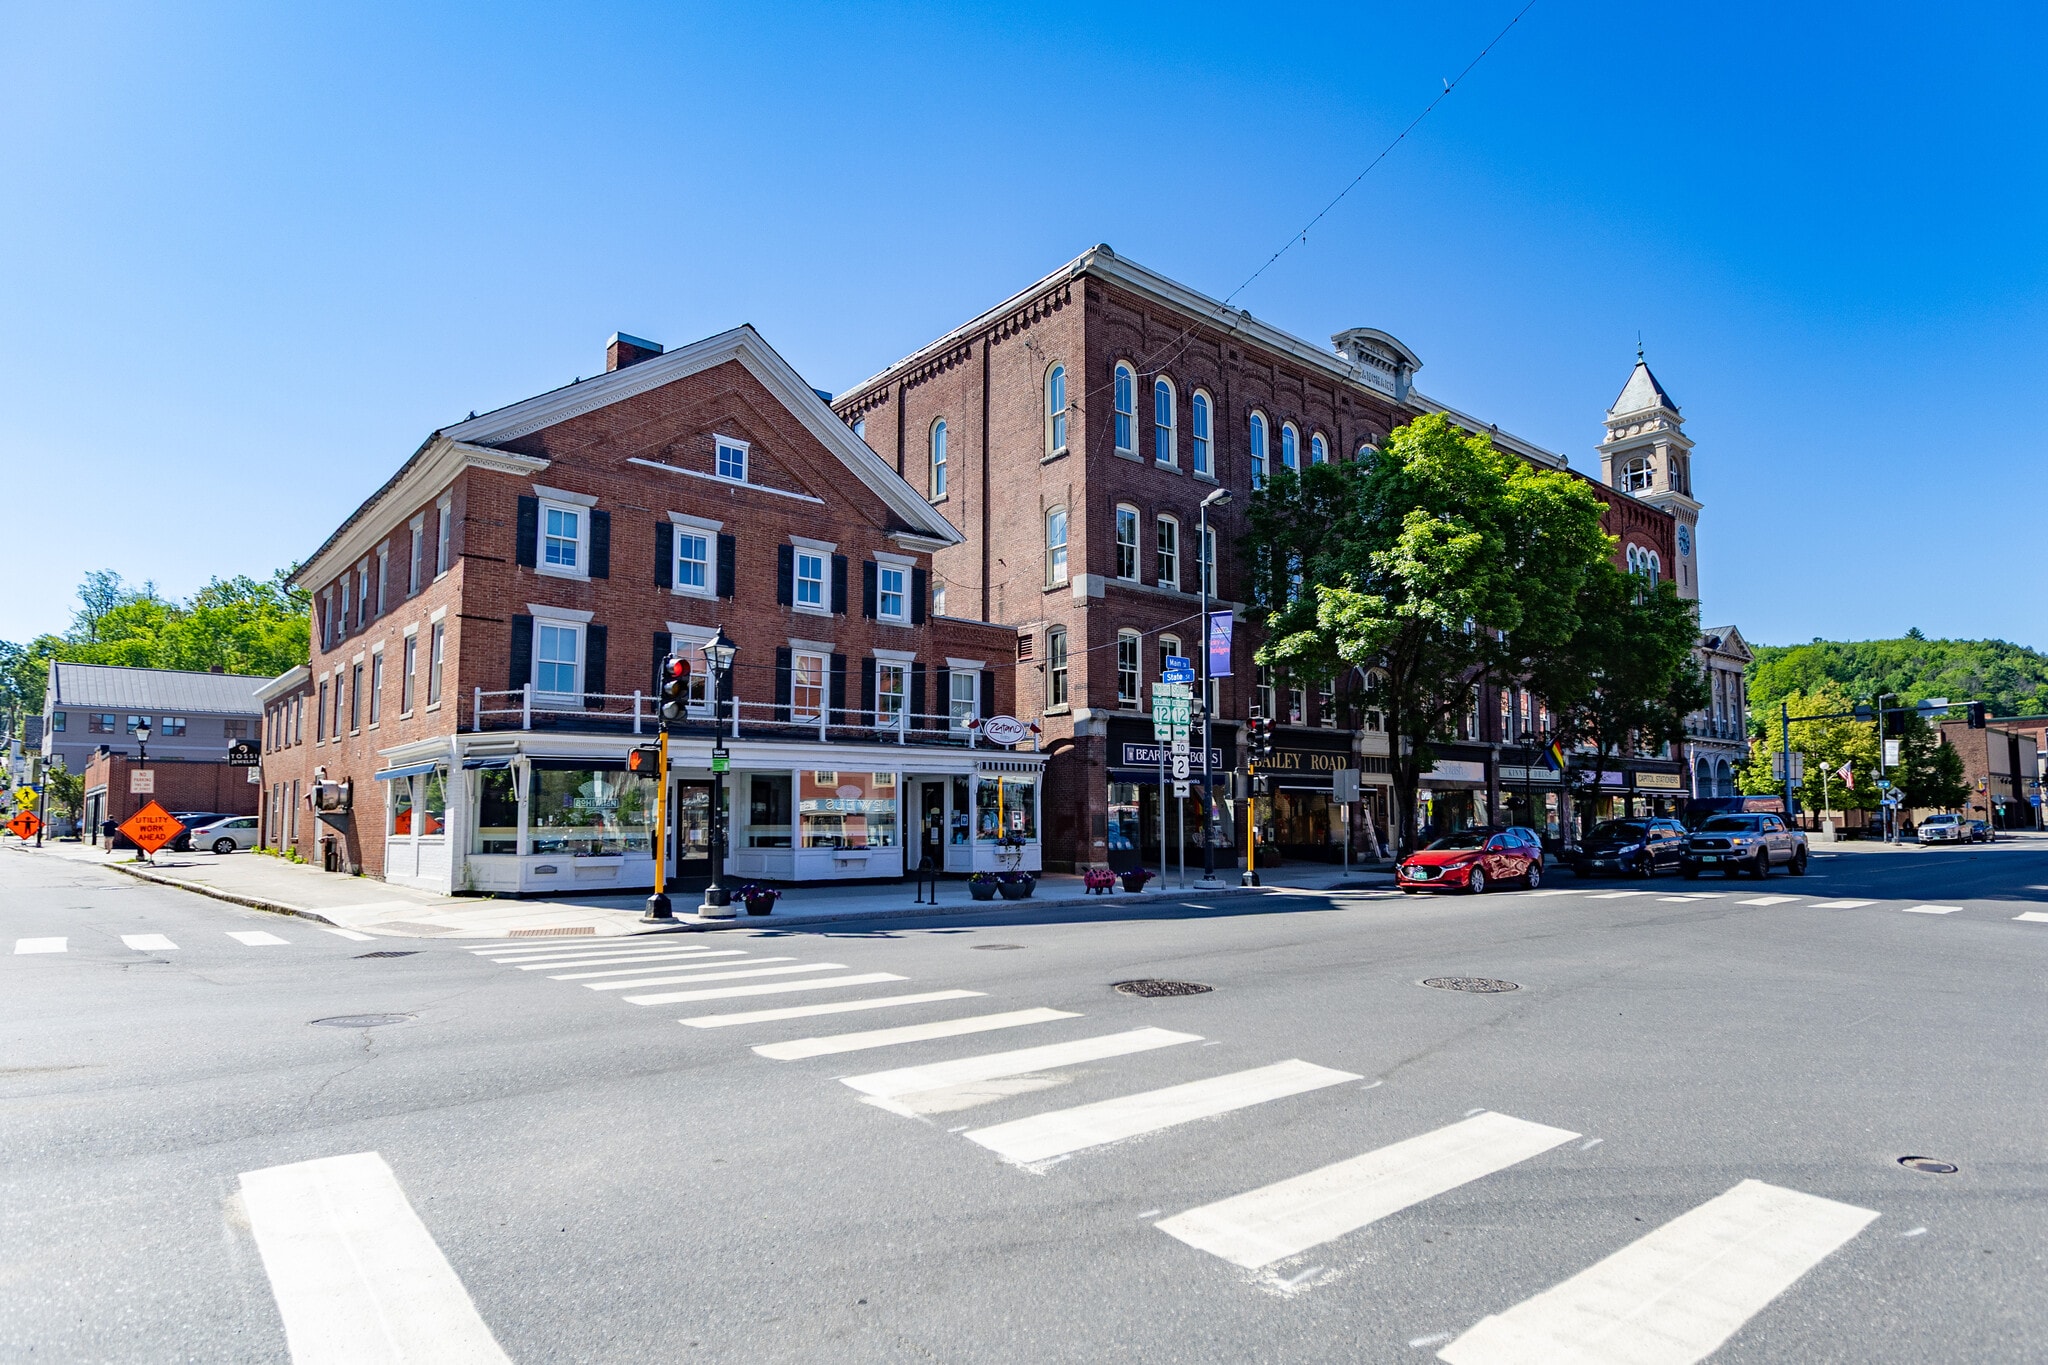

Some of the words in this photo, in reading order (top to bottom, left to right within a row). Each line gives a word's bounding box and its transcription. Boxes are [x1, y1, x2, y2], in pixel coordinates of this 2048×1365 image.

[1360, 369, 1395, 392] ANCHARD
[1169, 659, 1182, 667] Main
[1167, 673, 1183, 681] State
[1156, 707, 1168, 721] 12
[1175, 708, 1187, 722] 12
[1136, 749, 1160, 761] BEAR
[1190, 751, 1218, 764] BOOS
[1311, 754, 1347, 771] ROAD
[1178, 760, 1185, 774] 2
[1508, 769, 1527, 778] KINNE
[1637, 773, 1655, 782] CAPITOL
[1656, 774, 1679, 784] STATIONERS
[135, 816, 169, 824] UTILITY
[138, 833, 167, 841] AHEAD
